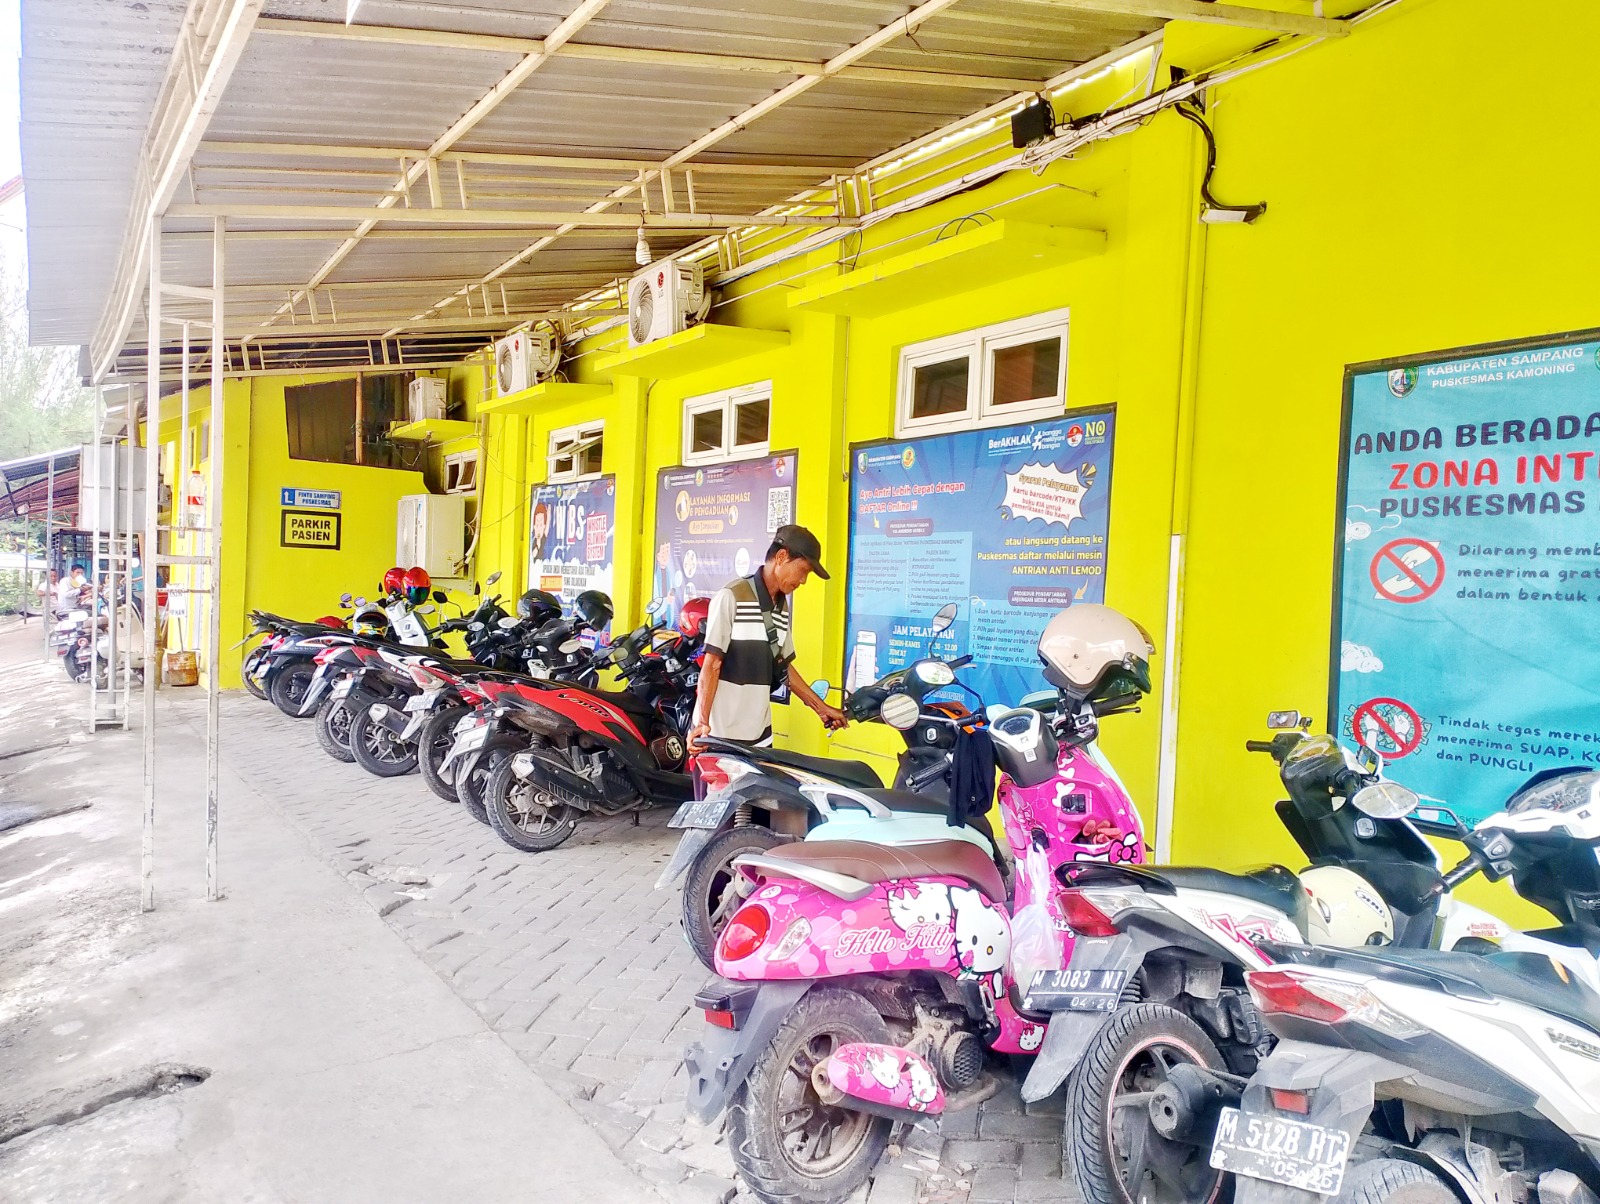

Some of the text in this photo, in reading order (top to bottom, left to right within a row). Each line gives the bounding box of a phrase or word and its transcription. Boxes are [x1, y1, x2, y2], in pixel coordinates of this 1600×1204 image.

[1427, 348, 1583, 376] KABUPATEN SAMPANG
[1432, 363, 1575, 388] PUSKESMAS KAMONING
[1085, 421, 1106, 437] NO
[1354, 412, 1600, 455] ANDA BERADA
[988, 434, 1031, 449] BerAKHLAK
[1388, 451, 1600, 490] ZONA INT
[860, 482, 965, 501] Ayo Antri Lebih Cepat dengan
[1013, 486, 1028, 495] kartu
[690, 492, 751, 506] LAYANAN INFORMASI
[1380, 490, 1586, 518] PUSKESMAS
[694, 506, 729, 516] PENGADUAN
[860, 503, 886, 514] DAFTAR
[888, 501, 910, 512] Online
[1012, 502, 1044, 515] pemeriksaan
[1046, 502, 1062, 512] untuk
[291, 518, 331, 530] PARKIR
[555, 504, 585, 541] WBS
[292, 530, 331, 541] PASIEN
[1004, 534, 1103, 547] atau langsung datang ke
[977, 549, 1103, 560] Puskesmas daftar melalui mesin
[1458, 544, 1537, 559] Dilarang
[1012, 565, 1102, 575] ANTRIAN ANTI LEMOD
[1457, 568, 1549, 579] menerima
[1457, 586, 1587, 602] dalam bentuk
[892, 625, 909, 636] JAM
[1438, 715, 1490, 731] Tindak
[1497, 722, 1541, 737] tegas
[1437, 734, 1513, 751] menerima
[1520, 742, 1574, 760] SUAP,
[1436, 750, 1533, 773] dan PUNGLI
[834, 921, 956, 958] Hello Kitty
[1031, 971, 1122, 989] M 3083 NI
[1221, 1113, 1238, 1142] M
[1245, 1119, 1301, 1155] 5128
